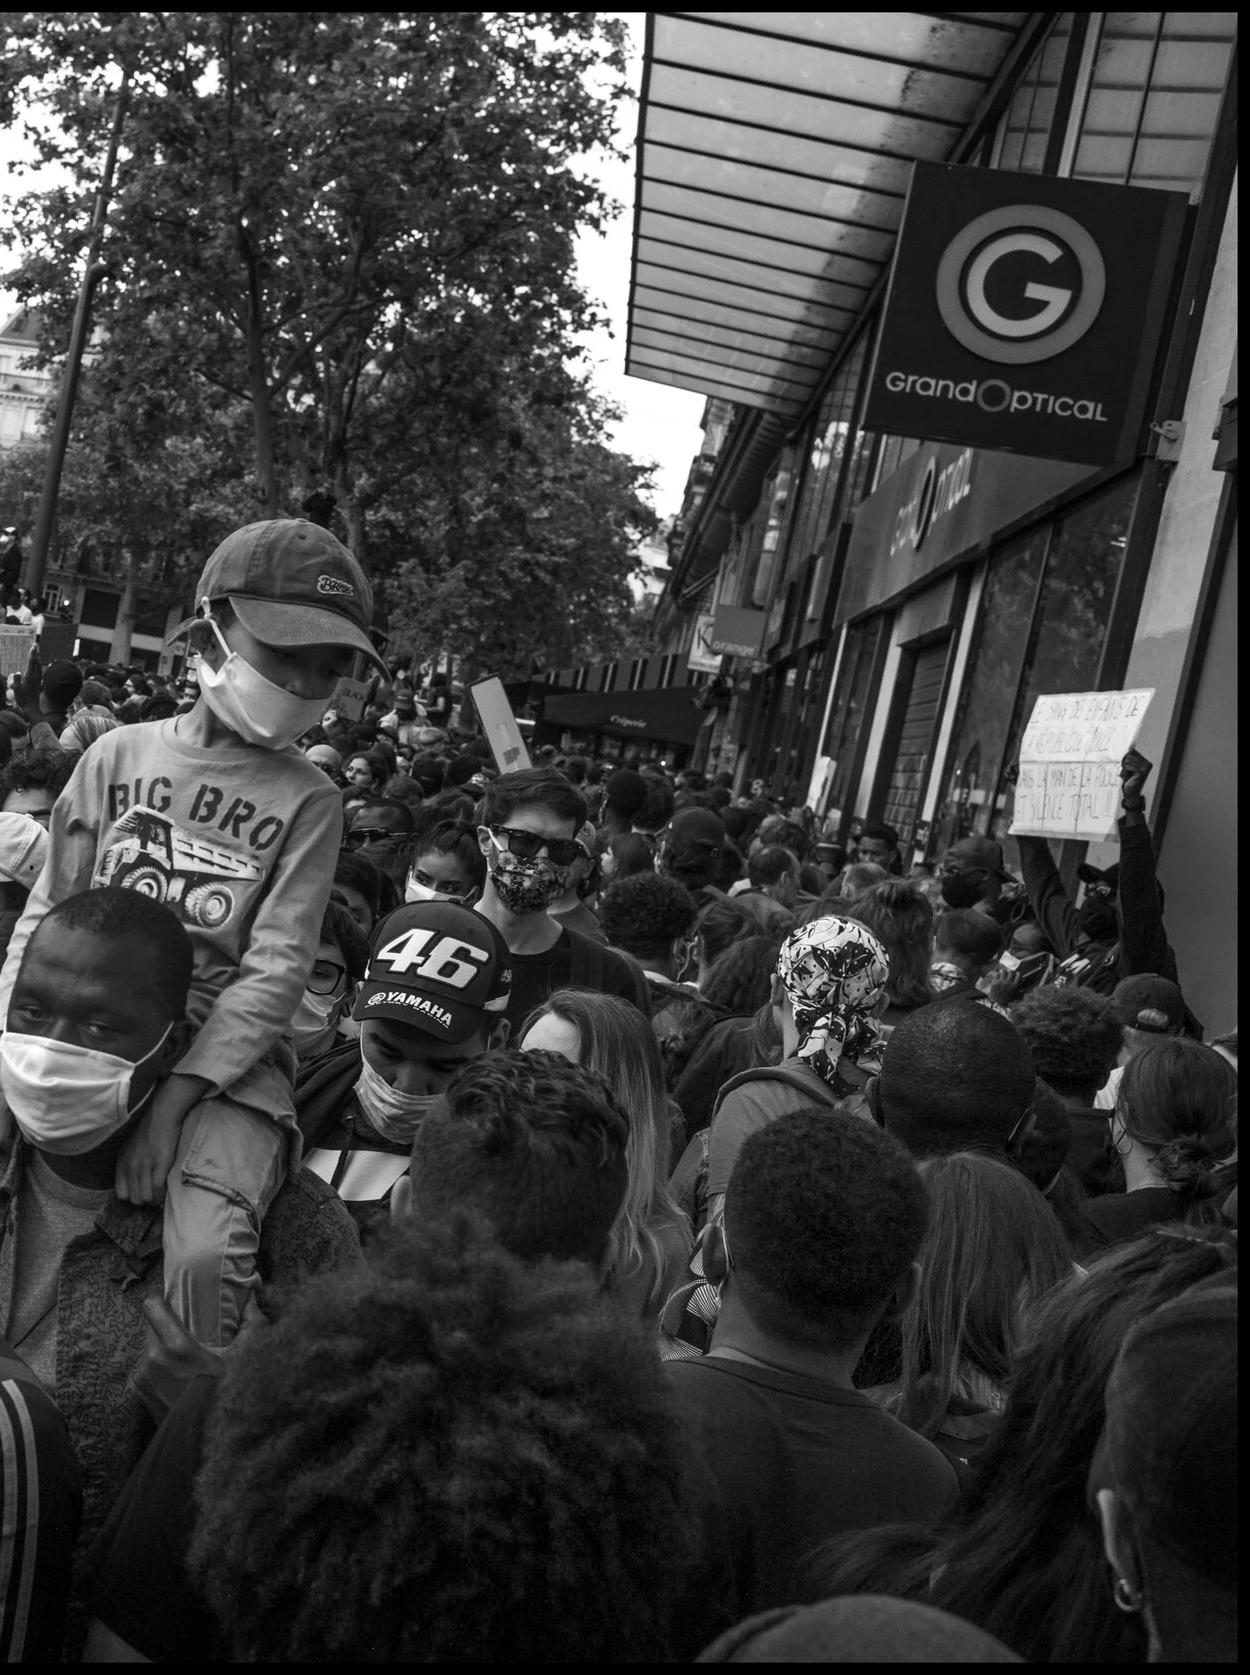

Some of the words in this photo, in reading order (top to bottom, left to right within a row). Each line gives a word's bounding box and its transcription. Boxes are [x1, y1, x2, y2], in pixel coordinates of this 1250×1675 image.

[712, 640, 755, 656] orange
[108, 776, 172, 822] BIG
[188, 783, 284, 851] BRO
[376, 928, 490, 989] 46
[386, 991, 453, 1027] YAMAHA
